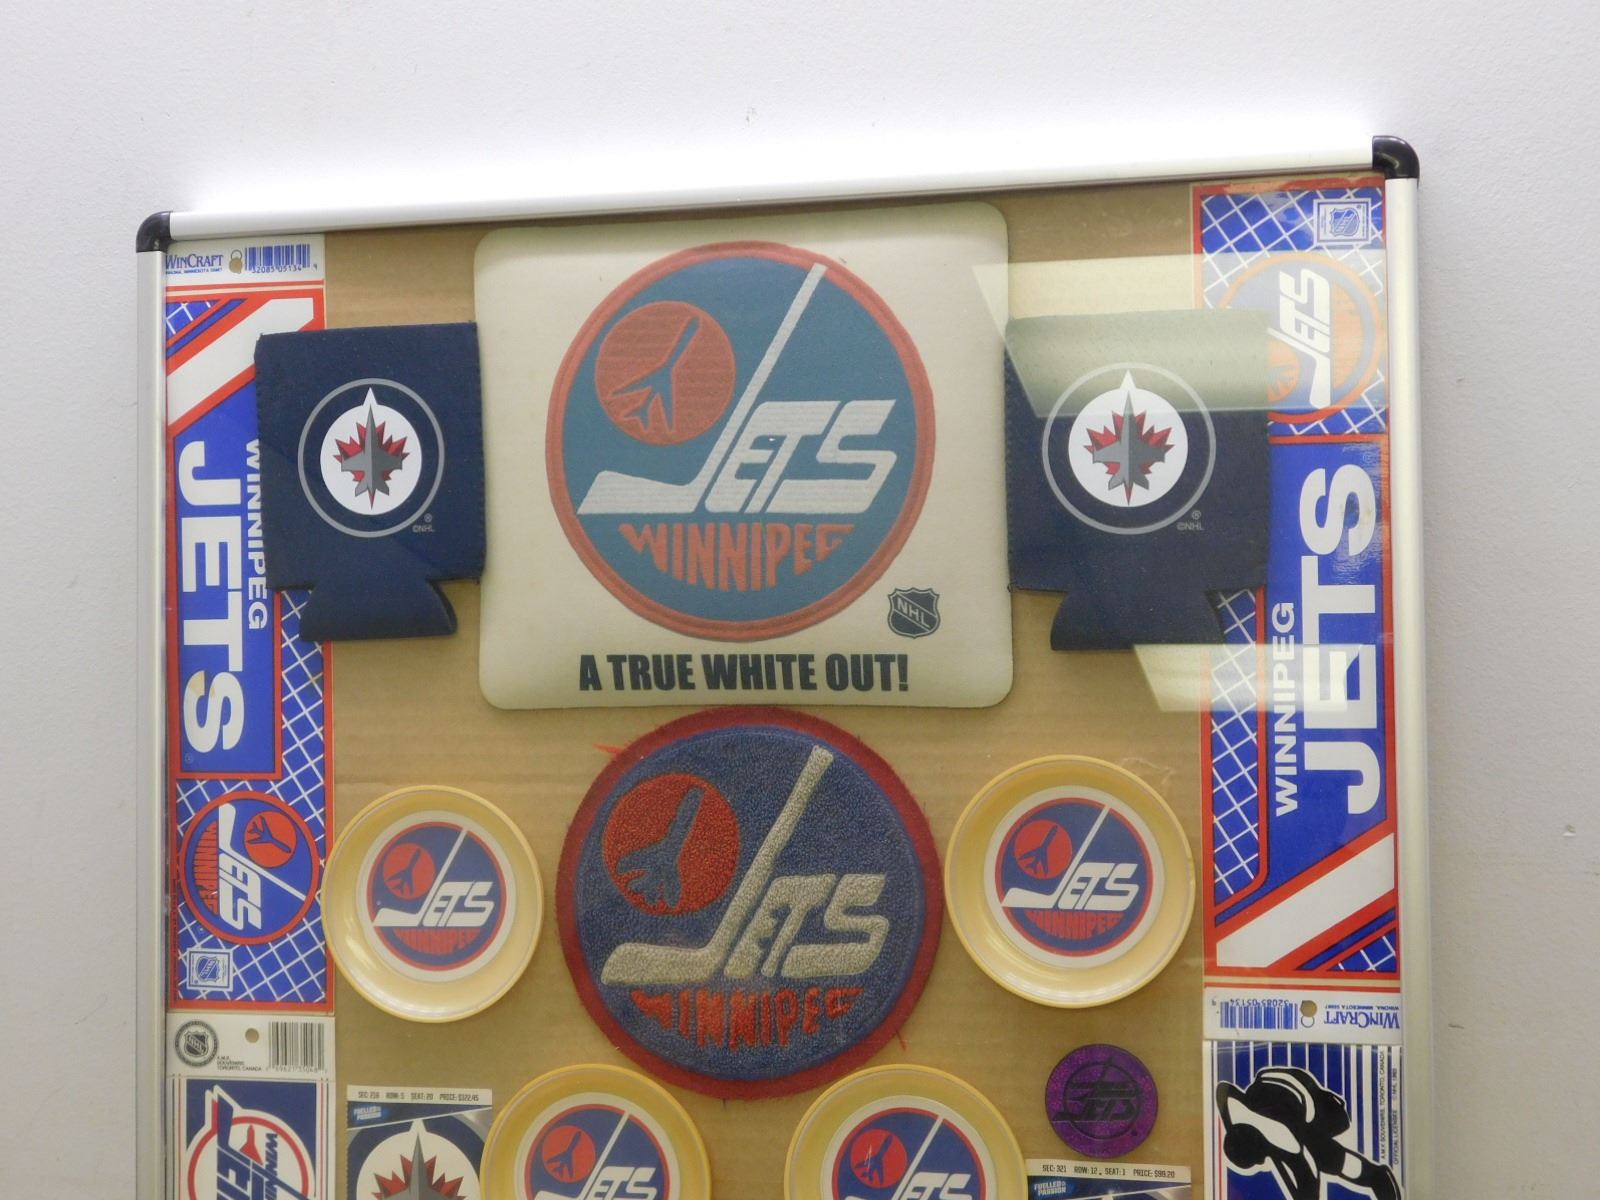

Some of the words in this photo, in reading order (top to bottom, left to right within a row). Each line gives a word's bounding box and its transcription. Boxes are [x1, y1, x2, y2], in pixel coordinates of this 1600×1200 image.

[577, 262, 898, 515] JETS
[246, 438, 268, 630] WINNIPEG
[617, 522, 855, 593] WINNIPEG
[178, 440, 245, 753] JETS
[897, 596, 931, 629] NHL
[1299, 463, 1381, 815] JETS
[579, 654, 602, 692] A
[607, 653, 696, 692] TRUE
[691, 653, 818, 692] WHITE
[825, 653, 909, 692] OUT!
[1271, 601, 1299, 818] WINNIPEG
[218, 802, 308, 931] JETS
[373, 828, 495, 928] JETS
[600, 744, 890, 985] JETS
[1001, 804, 1140, 912] JETS
[216, 1094, 312, 1200] JET
[534, 1110, 658, 1200] JETS
[1056, 1165, 1067, 1173] 321
